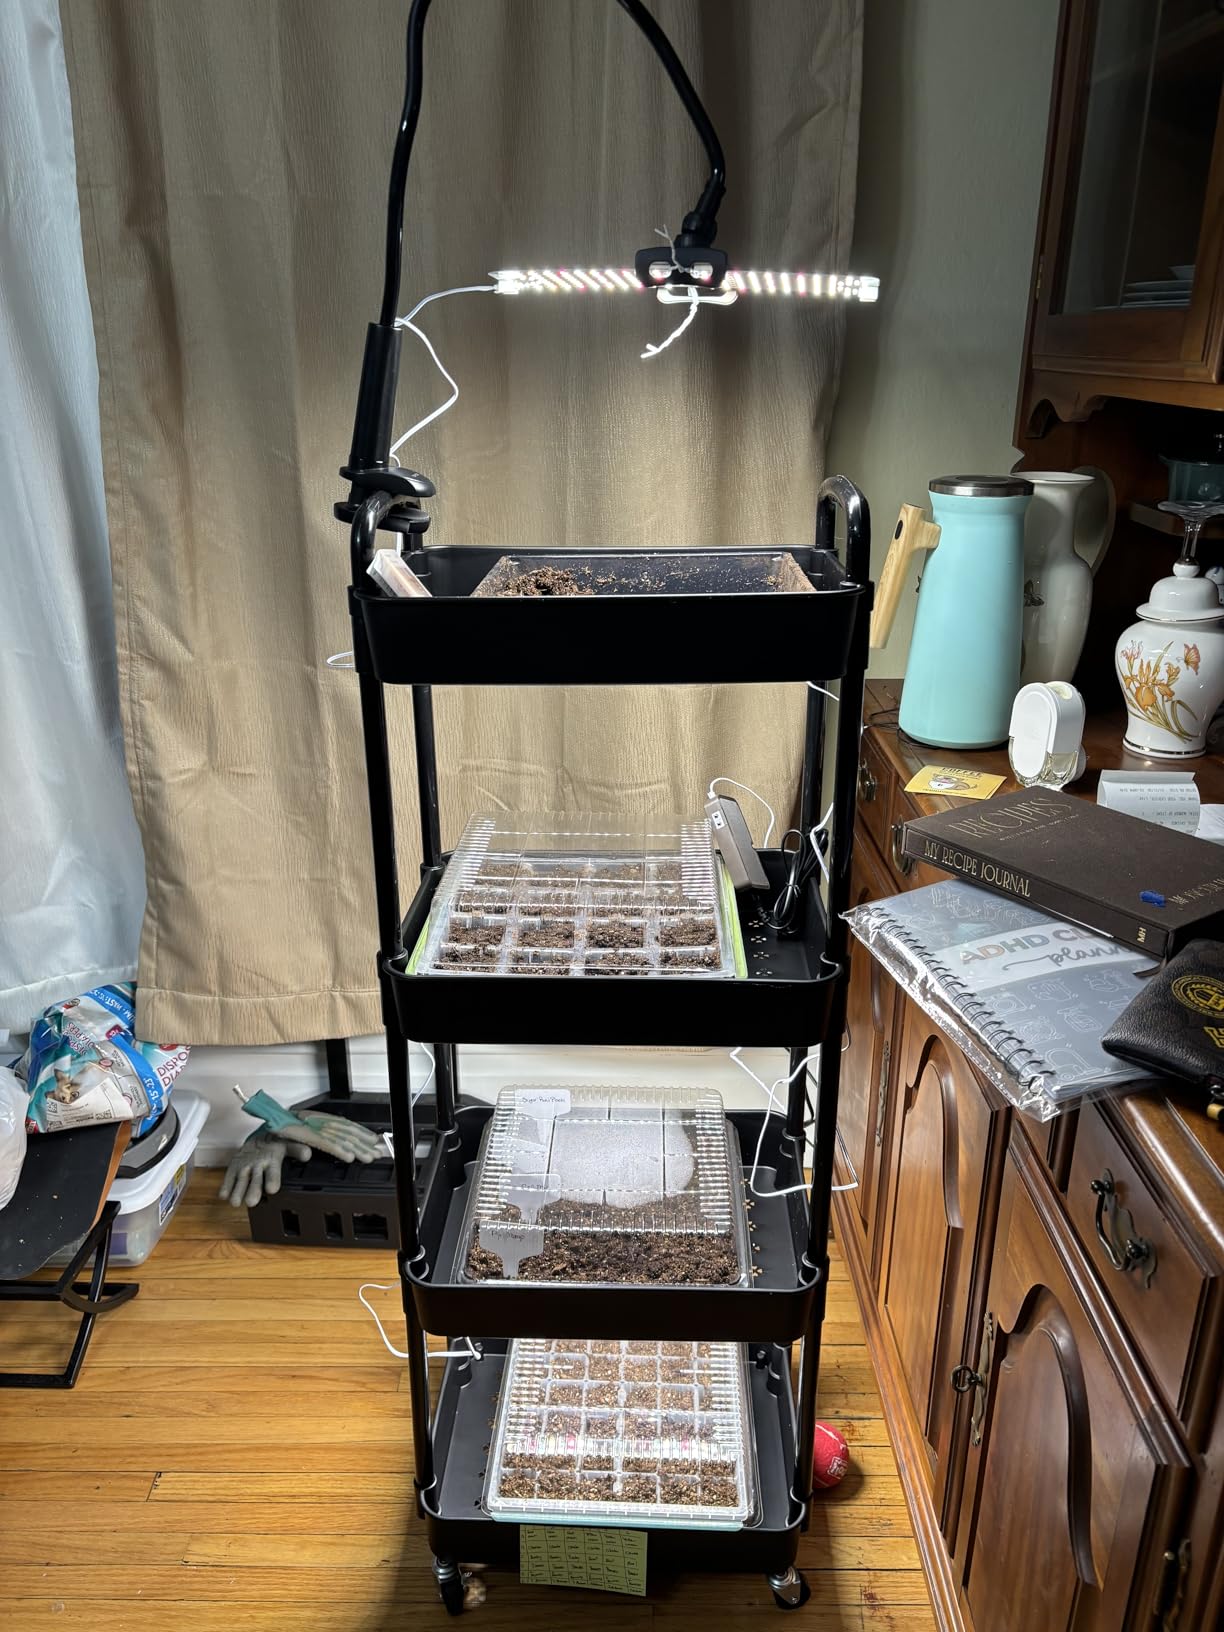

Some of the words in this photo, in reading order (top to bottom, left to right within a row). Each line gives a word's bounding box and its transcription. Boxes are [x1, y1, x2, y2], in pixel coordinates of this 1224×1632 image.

[924, 839, 940, 860] MY
[942, 846, 977, 876] RECIPE
[980, 862, 1032, 898] JOURNAL
[960, 934, 1050, 965] ADHD
[1053, 927, 1095, 942] CL
[1137, 927, 1147, 943] MH
